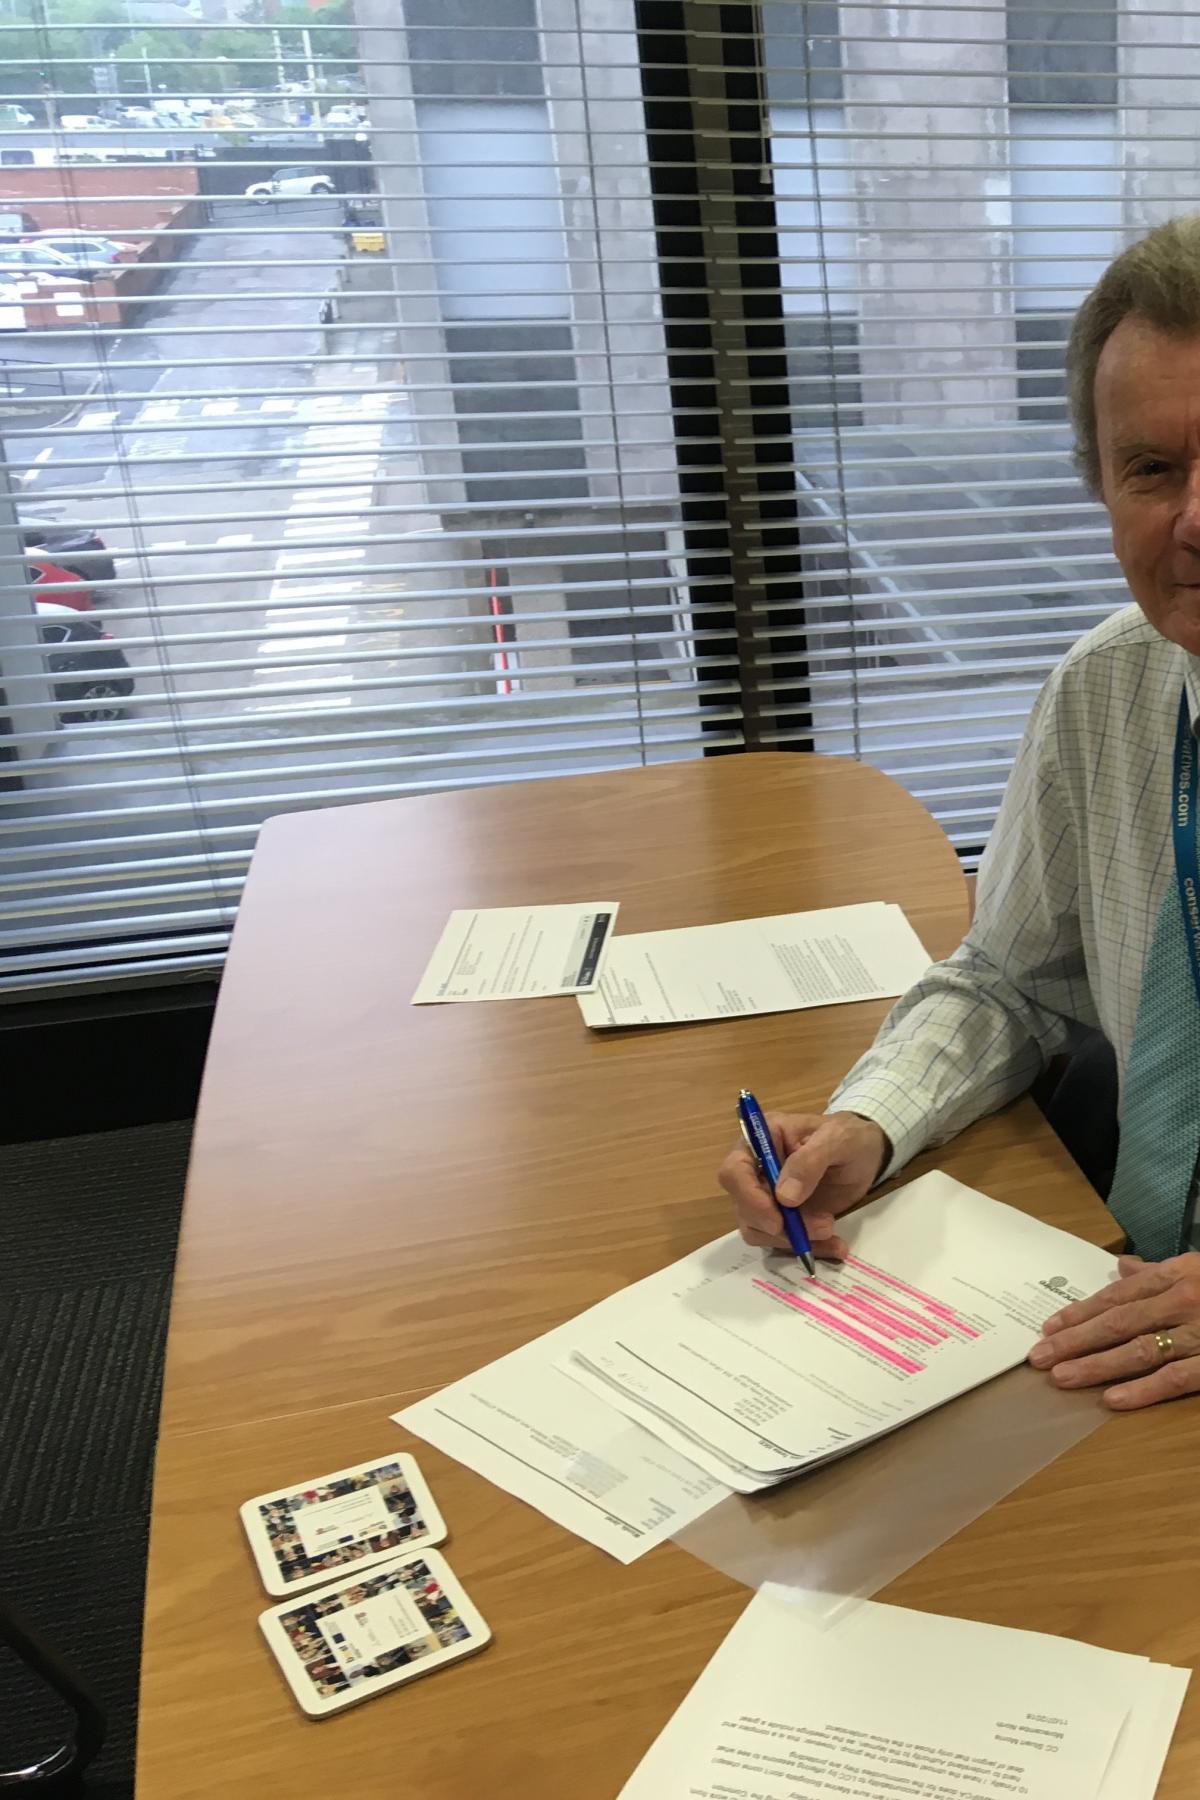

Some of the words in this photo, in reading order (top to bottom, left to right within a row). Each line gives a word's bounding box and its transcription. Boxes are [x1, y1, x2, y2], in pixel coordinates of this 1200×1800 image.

[995, 1722, 1017, 1730] North
[1018, 1725, 1064, 1739] Morecambe
[947, 1761, 991, 1774] understand
[962, 1774, 982, 1783] have
